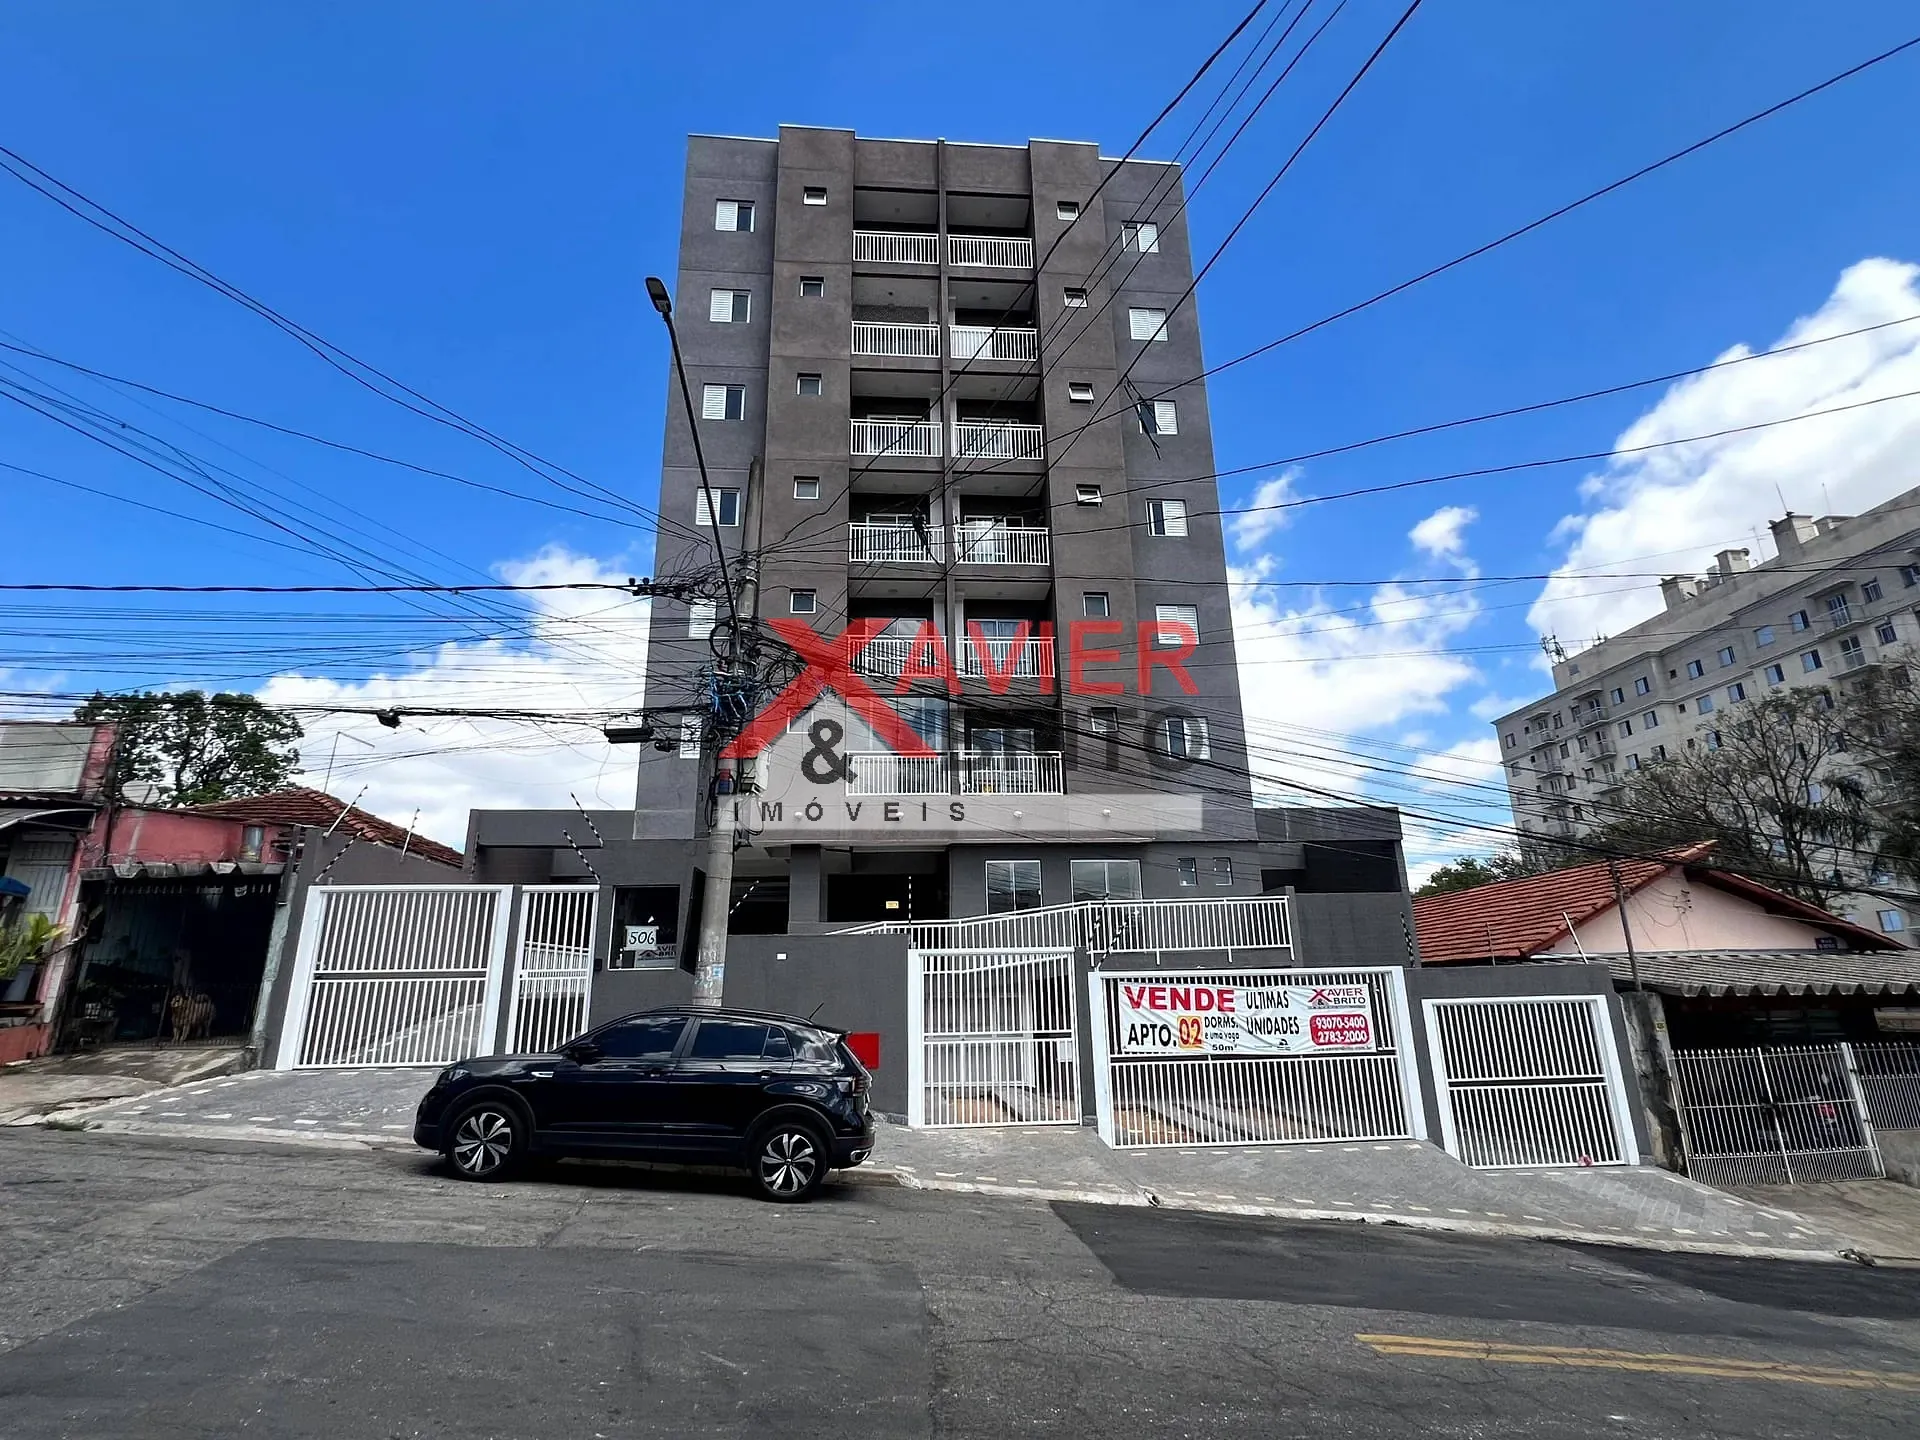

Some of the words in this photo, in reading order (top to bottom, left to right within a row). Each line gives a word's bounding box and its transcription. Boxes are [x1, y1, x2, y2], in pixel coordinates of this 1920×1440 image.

[629, 931, 655, 945] 506
[1124, 986, 1236, 1013] VENDE
[1246, 990, 1289, 1010] ULTIMAS
[1308, 987, 1363, 1003] XAVIER
[1333, 996, 1366, 1005] BRITO
[1204, 1016, 1239, 1029] DORMS.
[1246, 1016, 1300, 1035] UNIDADES
[1315, 1016, 1366, 1030] 93070-5400
[1127, 1023, 1177, 1047] APTO.
[1179, 1018, 1202, 1046] 02
[1317, 1030, 1368, 1044] 2783-2000
